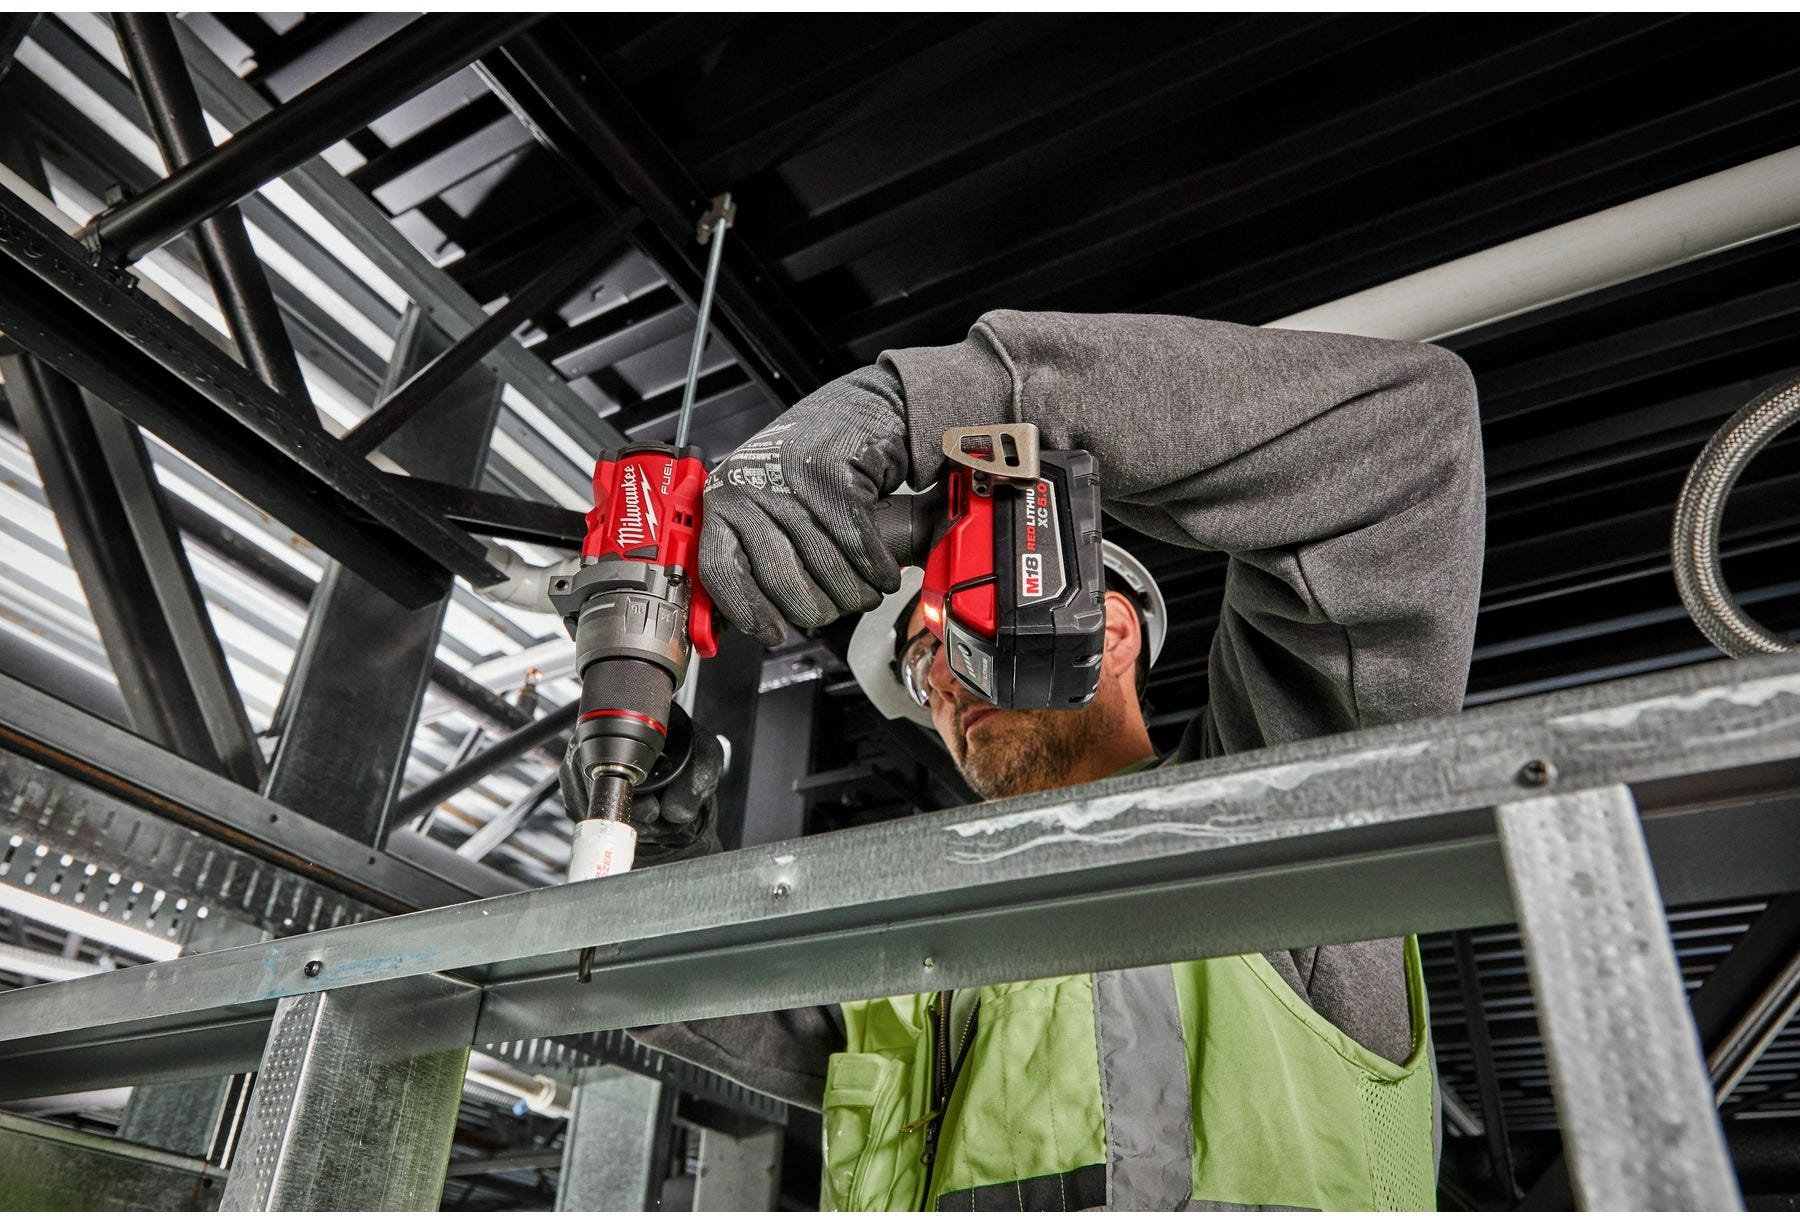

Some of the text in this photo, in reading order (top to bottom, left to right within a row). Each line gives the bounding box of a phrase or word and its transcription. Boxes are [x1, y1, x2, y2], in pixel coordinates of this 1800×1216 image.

[617, 464, 645, 549] Milwaukee
[661, 459, 674, 495] FUEL
[1025, 488, 1040, 594] M18 REDLITHIU
